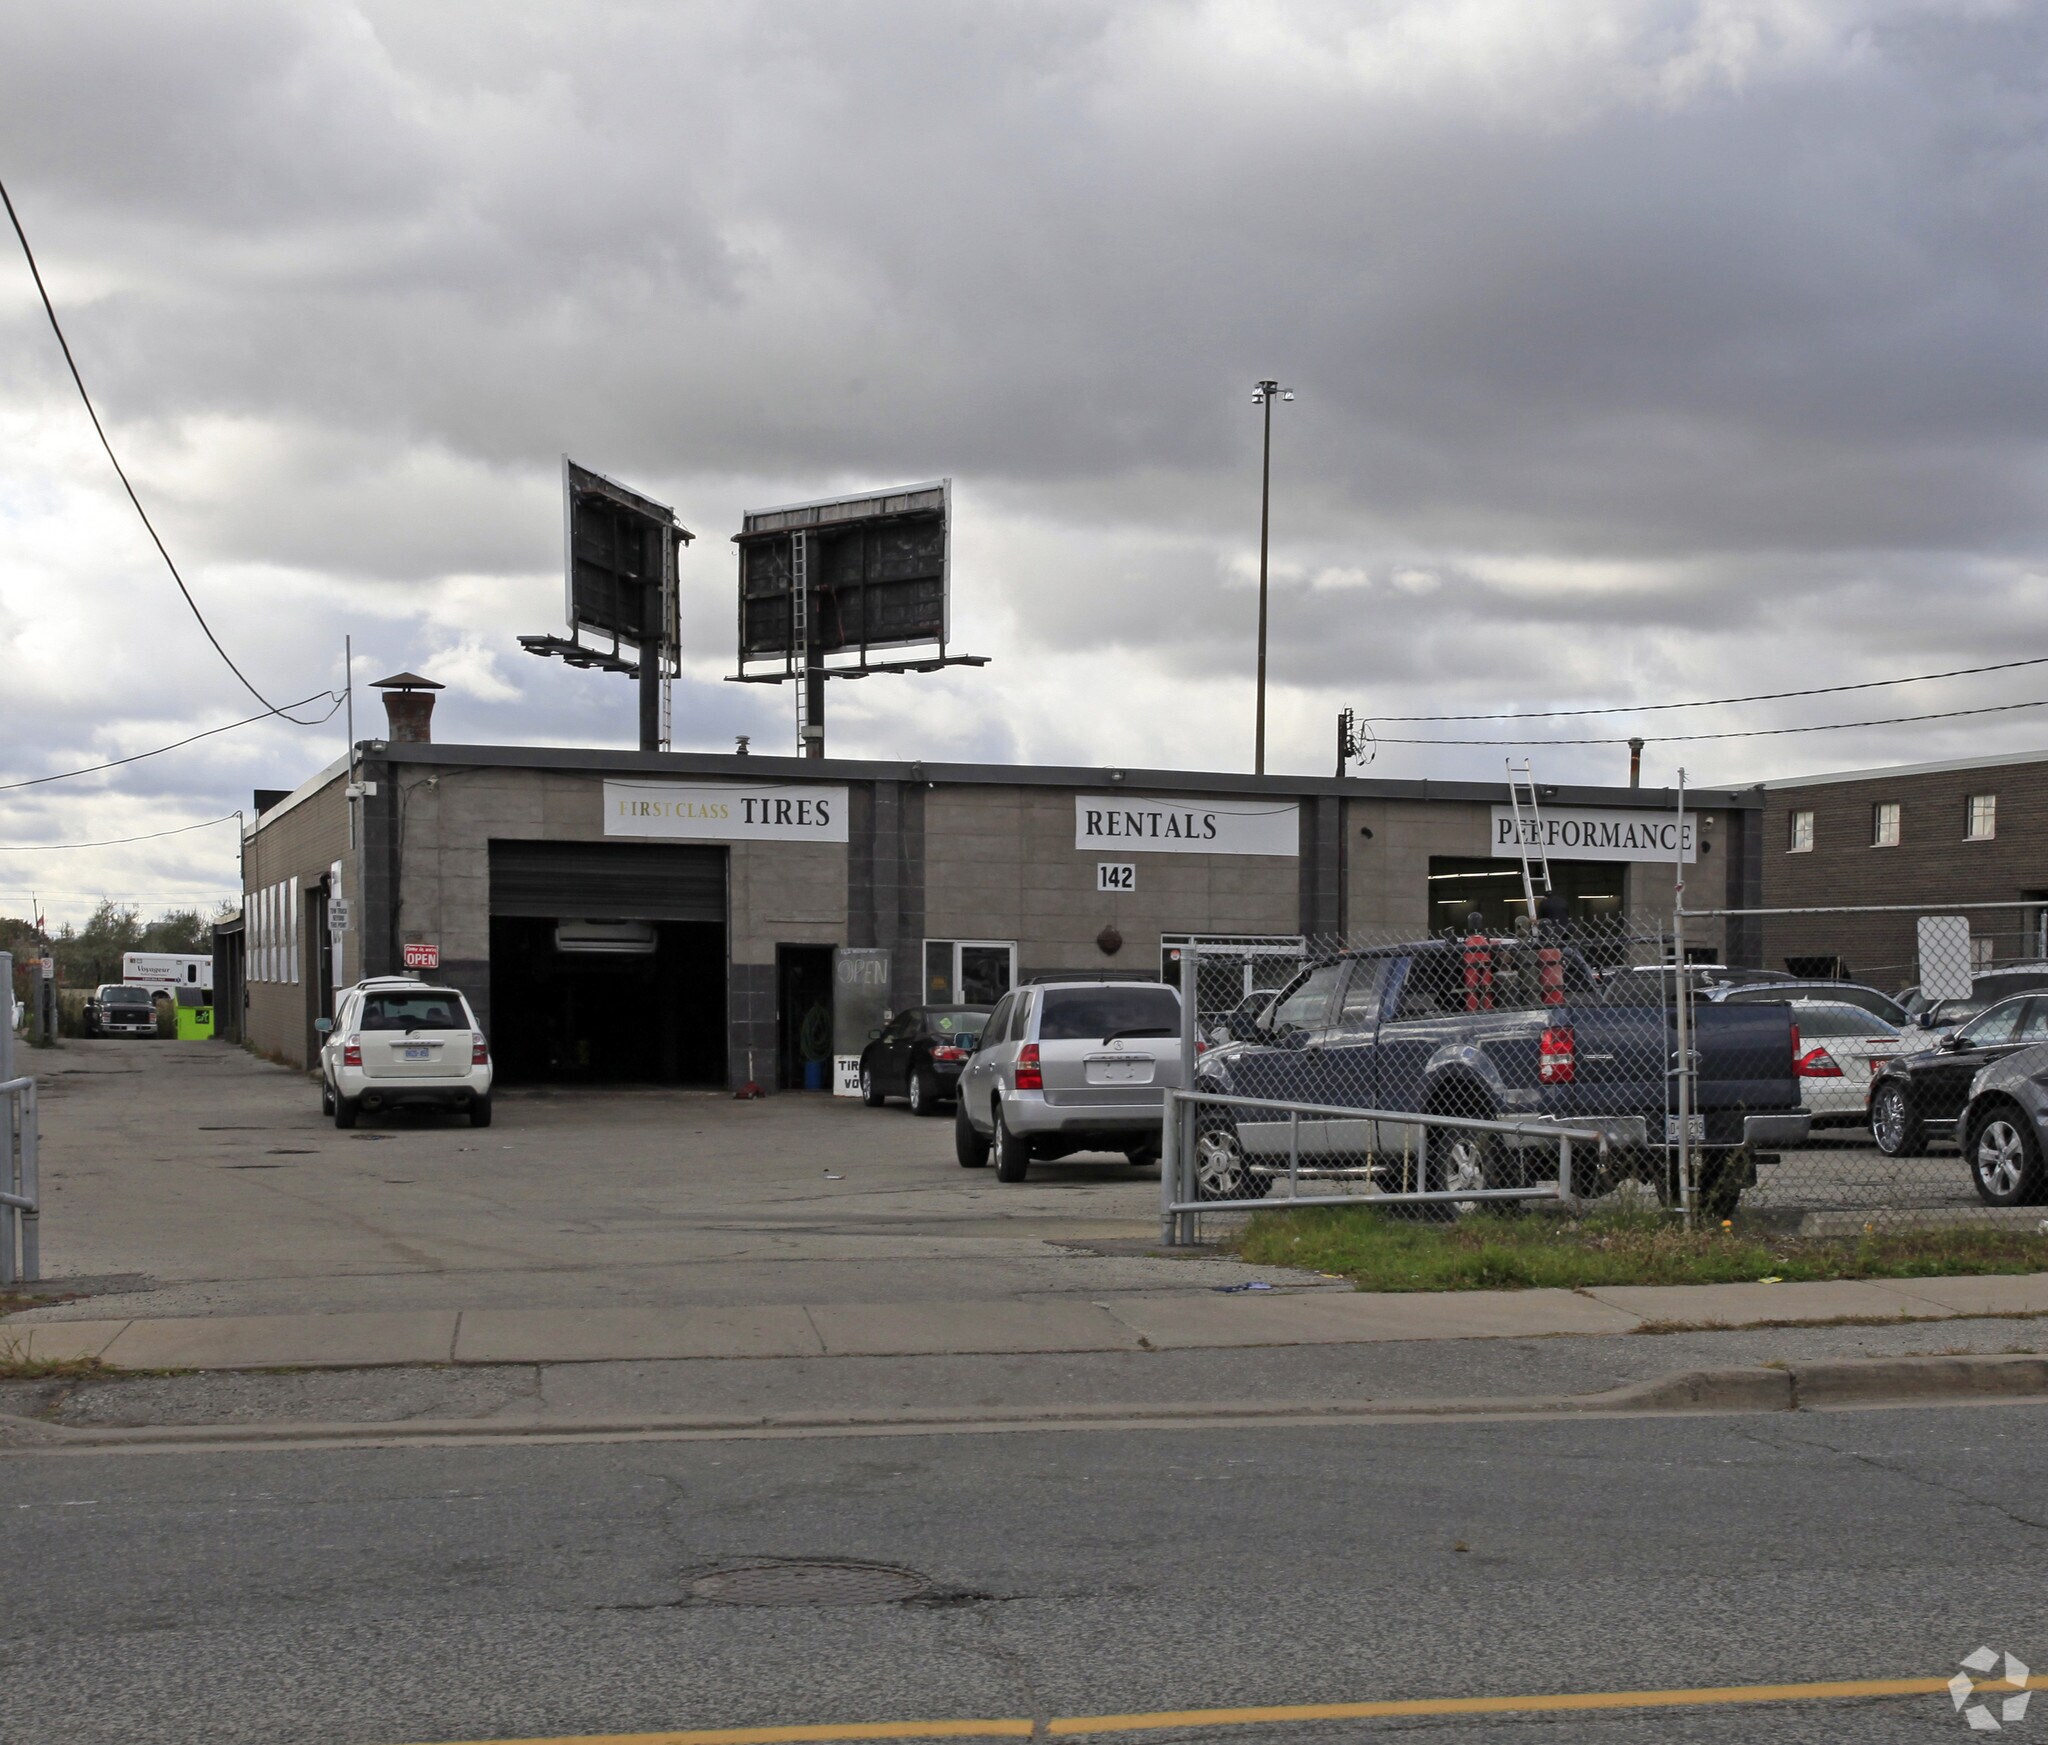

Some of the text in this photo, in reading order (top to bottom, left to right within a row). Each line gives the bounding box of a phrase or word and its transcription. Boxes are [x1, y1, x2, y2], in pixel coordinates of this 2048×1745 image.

[619, 798, 830, 827] FIRST CLASS TIRES
[1085, 810, 1217, 840] RENTALS
[1497, 818, 1692, 850] PERFORMANCE
[1100, 866, 1133, 888] 142
[137, 965, 171, 974] Voyageur
[406, 953, 437, 966] OPEN
[837, 958, 888, 985] OPEN
